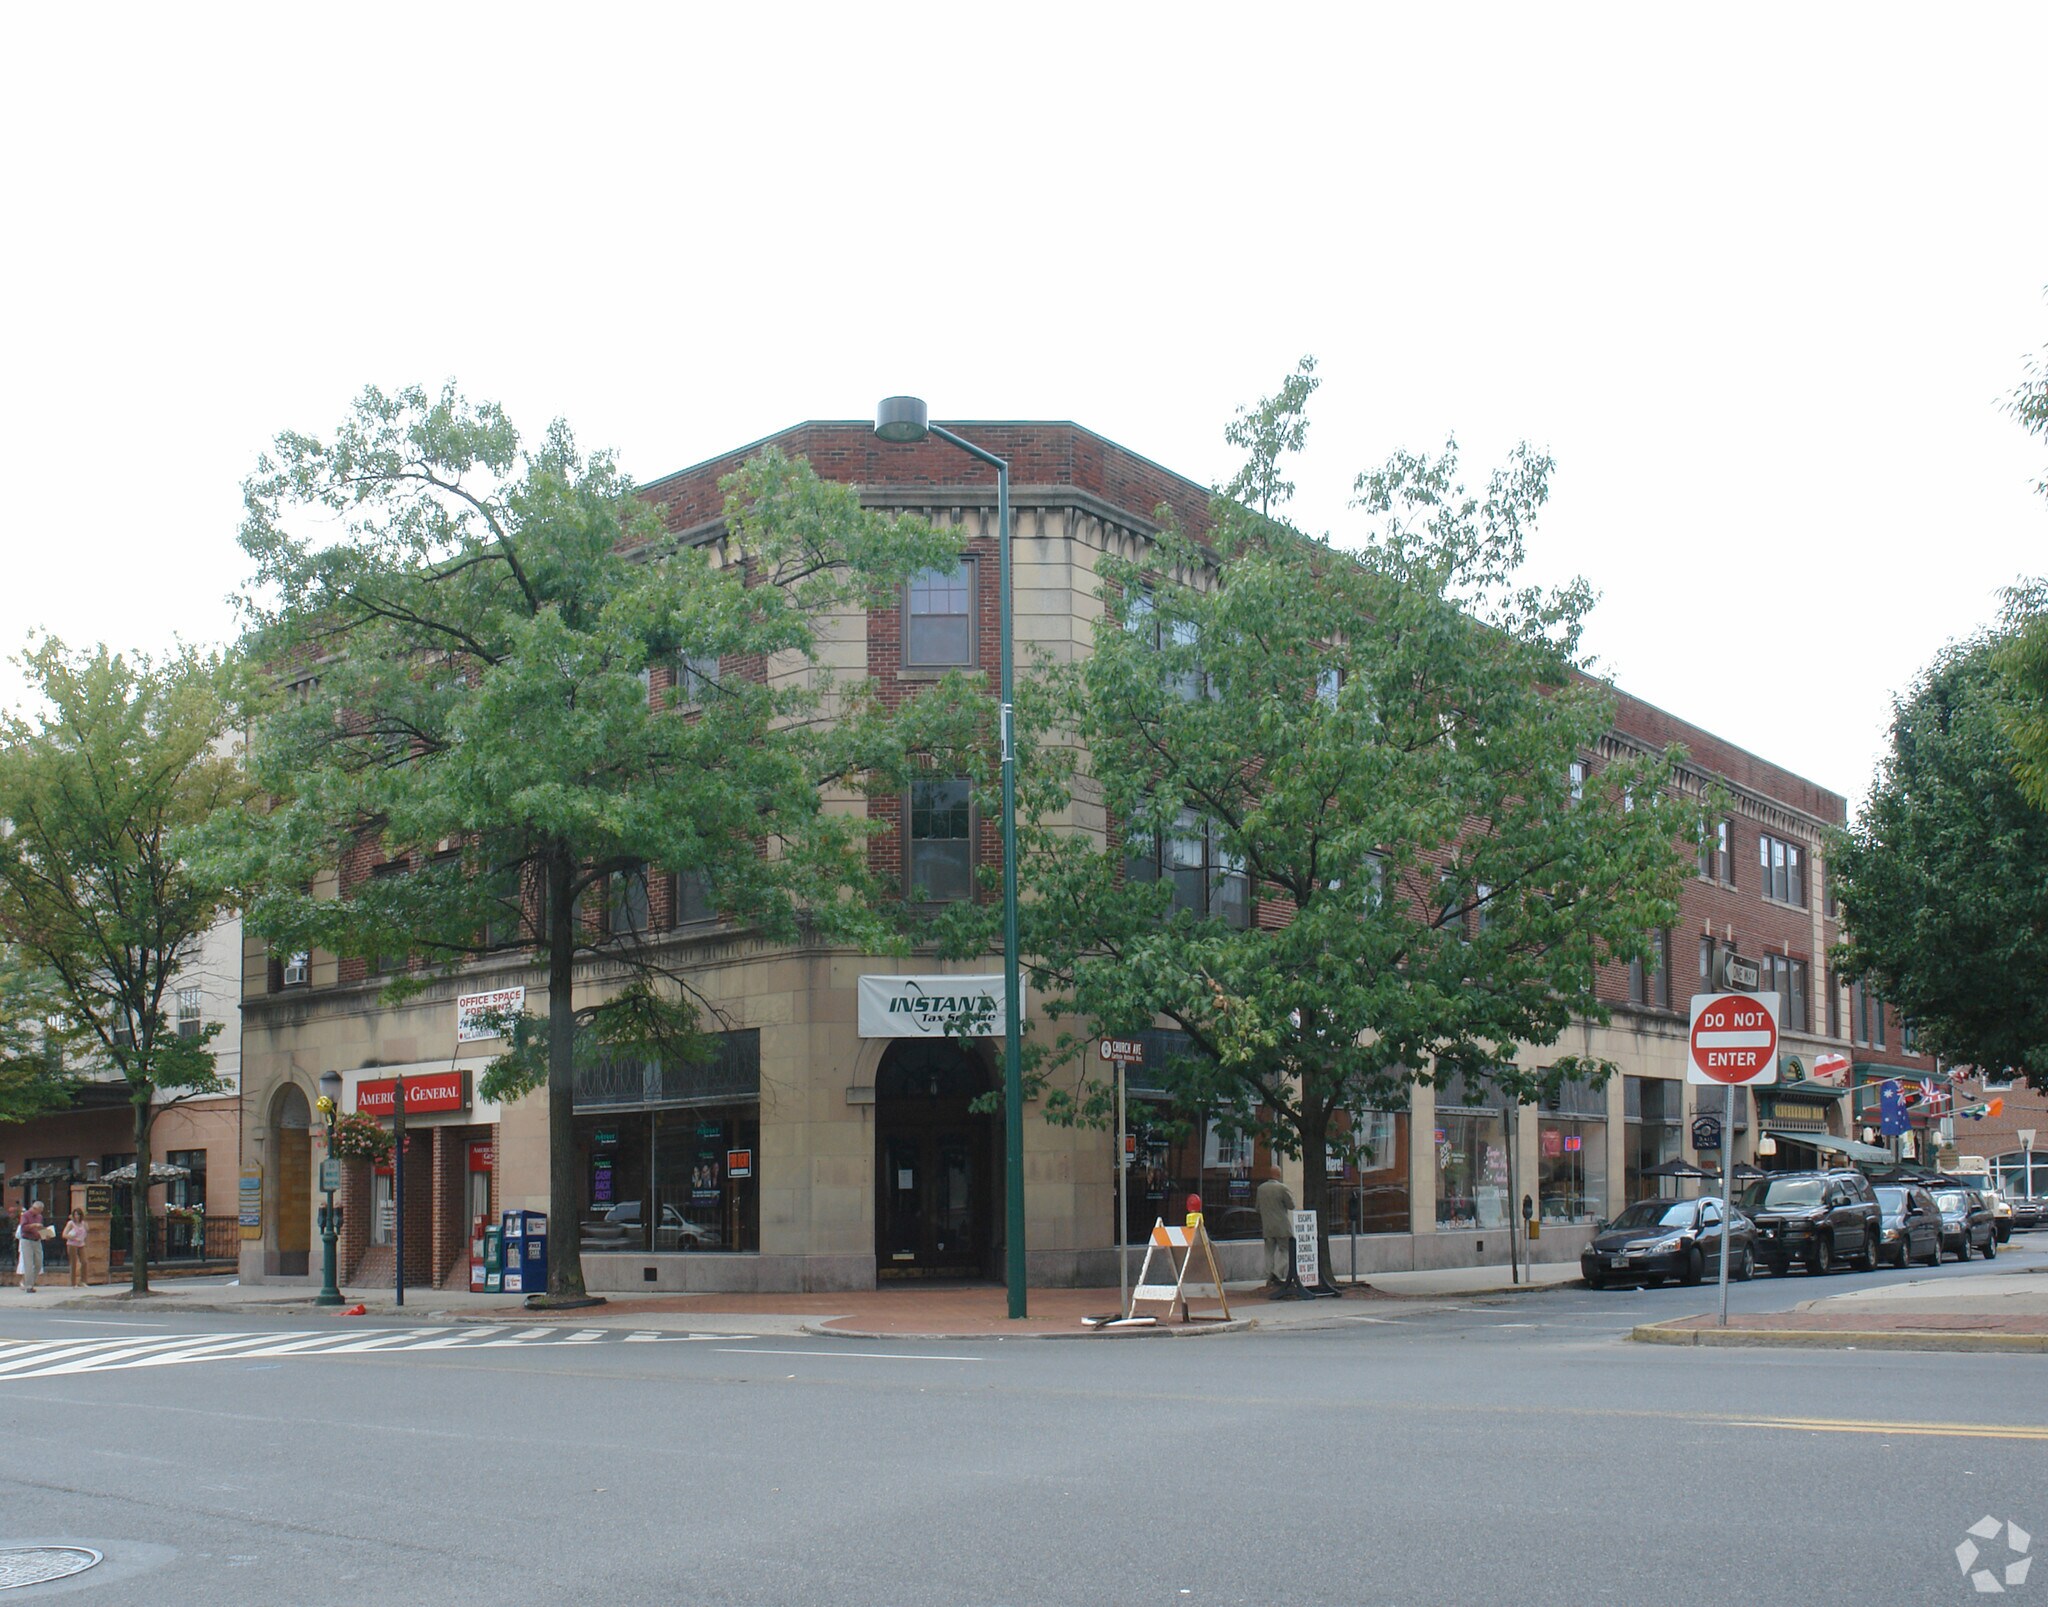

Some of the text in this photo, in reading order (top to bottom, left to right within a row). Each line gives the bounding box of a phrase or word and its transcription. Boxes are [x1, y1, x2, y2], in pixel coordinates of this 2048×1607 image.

[1733, 965, 1756, 986] ONE WAY
[460, 991, 520, 1007] OFFICE SPACE
[466, 1007, 482, 1015] FOR
[922, 1013, 945, 1021] Tax
[1705, 1012, 1765, 1028] DO NOT
[1112, 1041, 1142, 1056] CHURCH AVE
[1708, 1052, 1756, 1067] ENTER
[358, 1086, 459, 1106] AMERICN GENERAL
[595, 1170, 611, 1180] CASH
[595, 1180, 610, 1190] BACK
[1297, 1213, 1312, 1222] ESCAPE
[1295, 1224, 1304, 1232] YOUR
[1298, 1234, 1310, 1242] SALON
[1298, 1244, 1312, 1252] SCHOOL
[1297, 1253, 1315, 1263] SPECIALS
